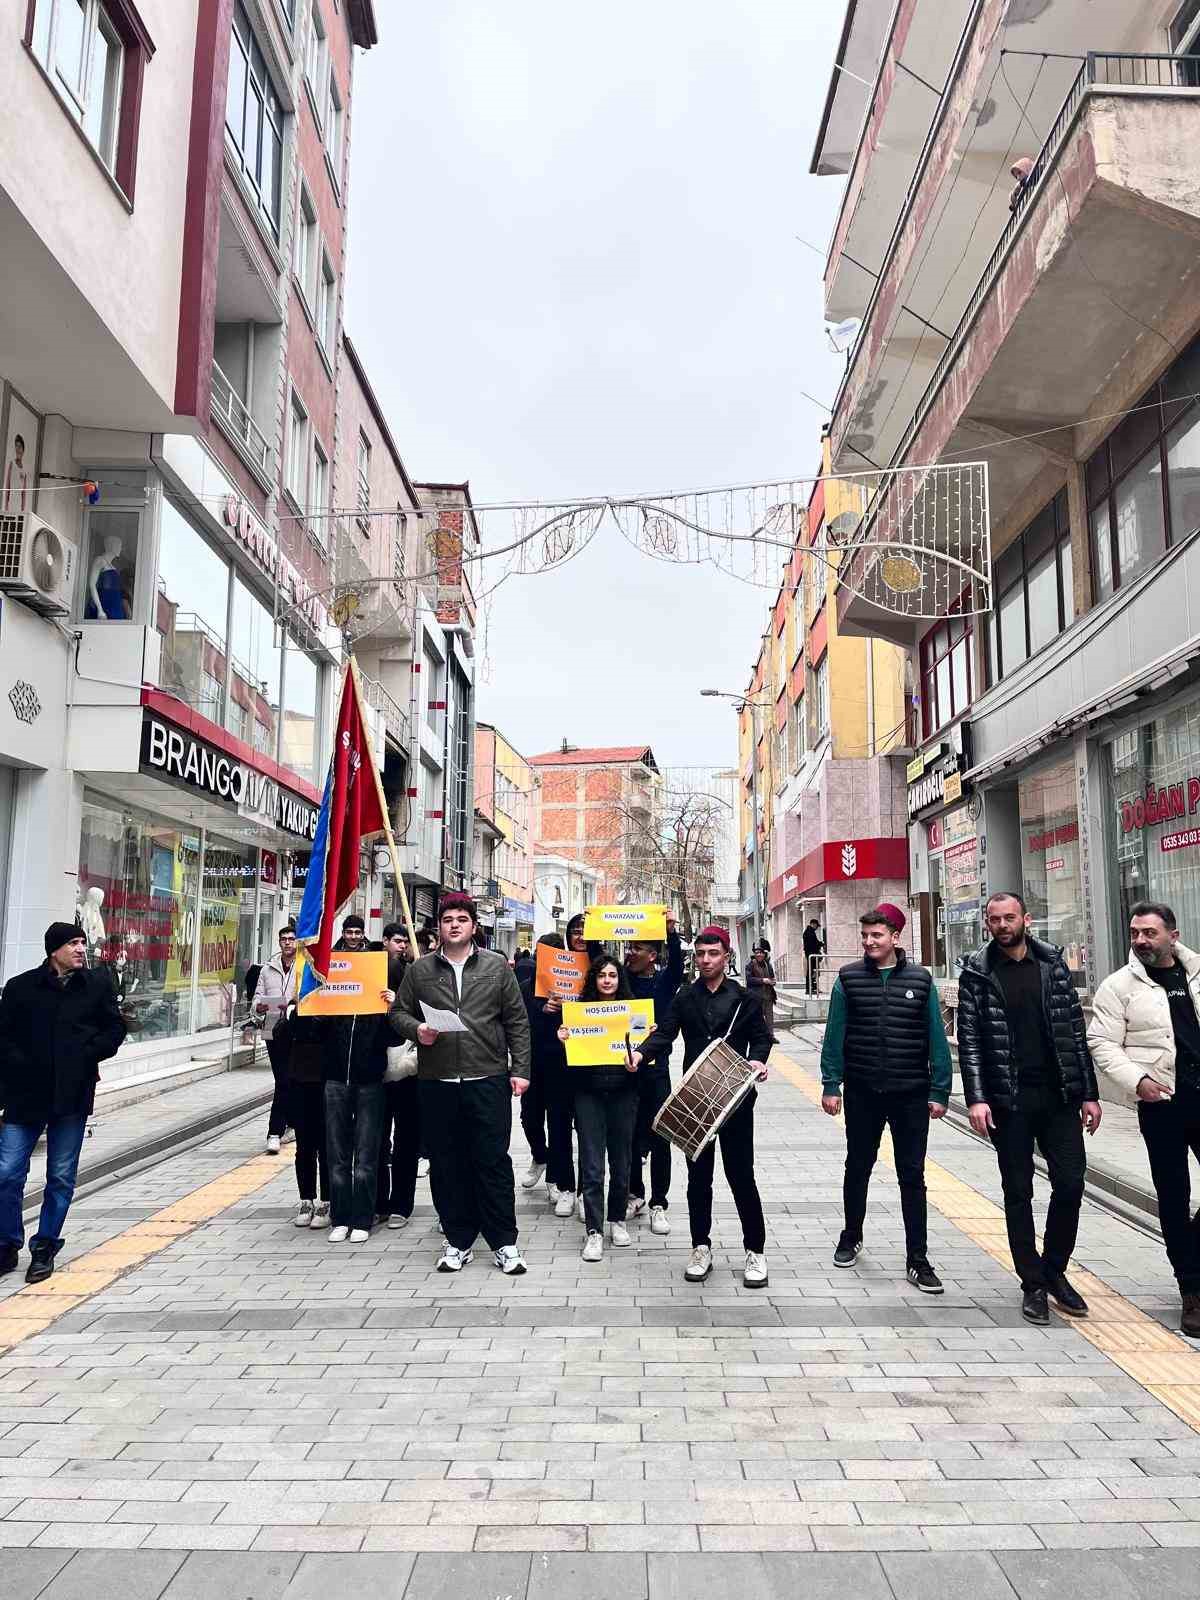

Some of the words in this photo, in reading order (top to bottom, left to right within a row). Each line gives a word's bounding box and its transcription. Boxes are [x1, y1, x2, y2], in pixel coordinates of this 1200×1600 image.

[150, 721, 242, 802] BRANGO
[281, 796, 310, 836] YAKUP
[1121, 780, 1186, 833] DOĞAN
[1163, 835, 1177, 850] 0535
[1177, 832, 1189, 846] 343
[585, 1007, 600, 1015] HOŞ
[601, 1005, 626, 1013] GELDİN
